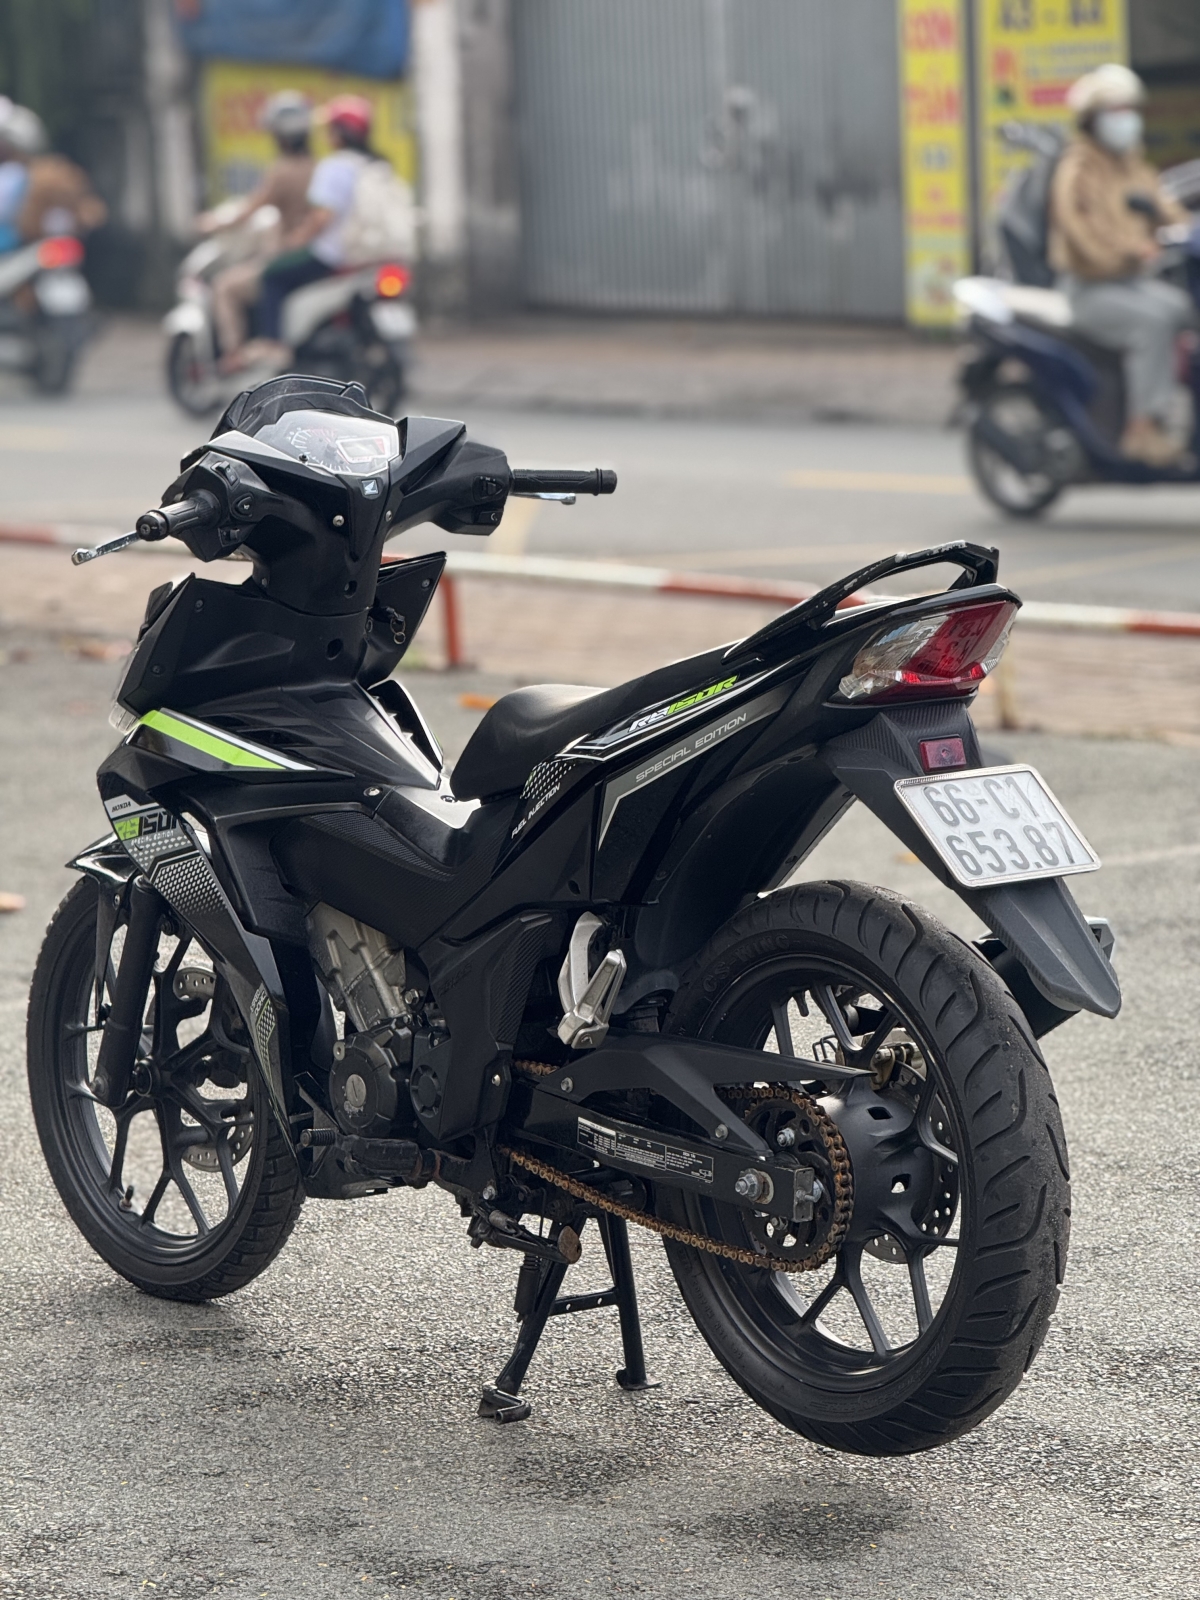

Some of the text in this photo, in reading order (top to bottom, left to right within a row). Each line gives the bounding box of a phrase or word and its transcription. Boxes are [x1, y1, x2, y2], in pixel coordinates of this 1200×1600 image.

[628, 675, 738, 733] RS150R
[635, 712, 747, 783] SPECIAL EDITION
[111, 800, 131, 813] HONDA
[511, 781, 560, 839] FUEL INJECTION
[922, 776, 1040, 827] 66-C1
[946, 821, 1075, 876] 653.87
